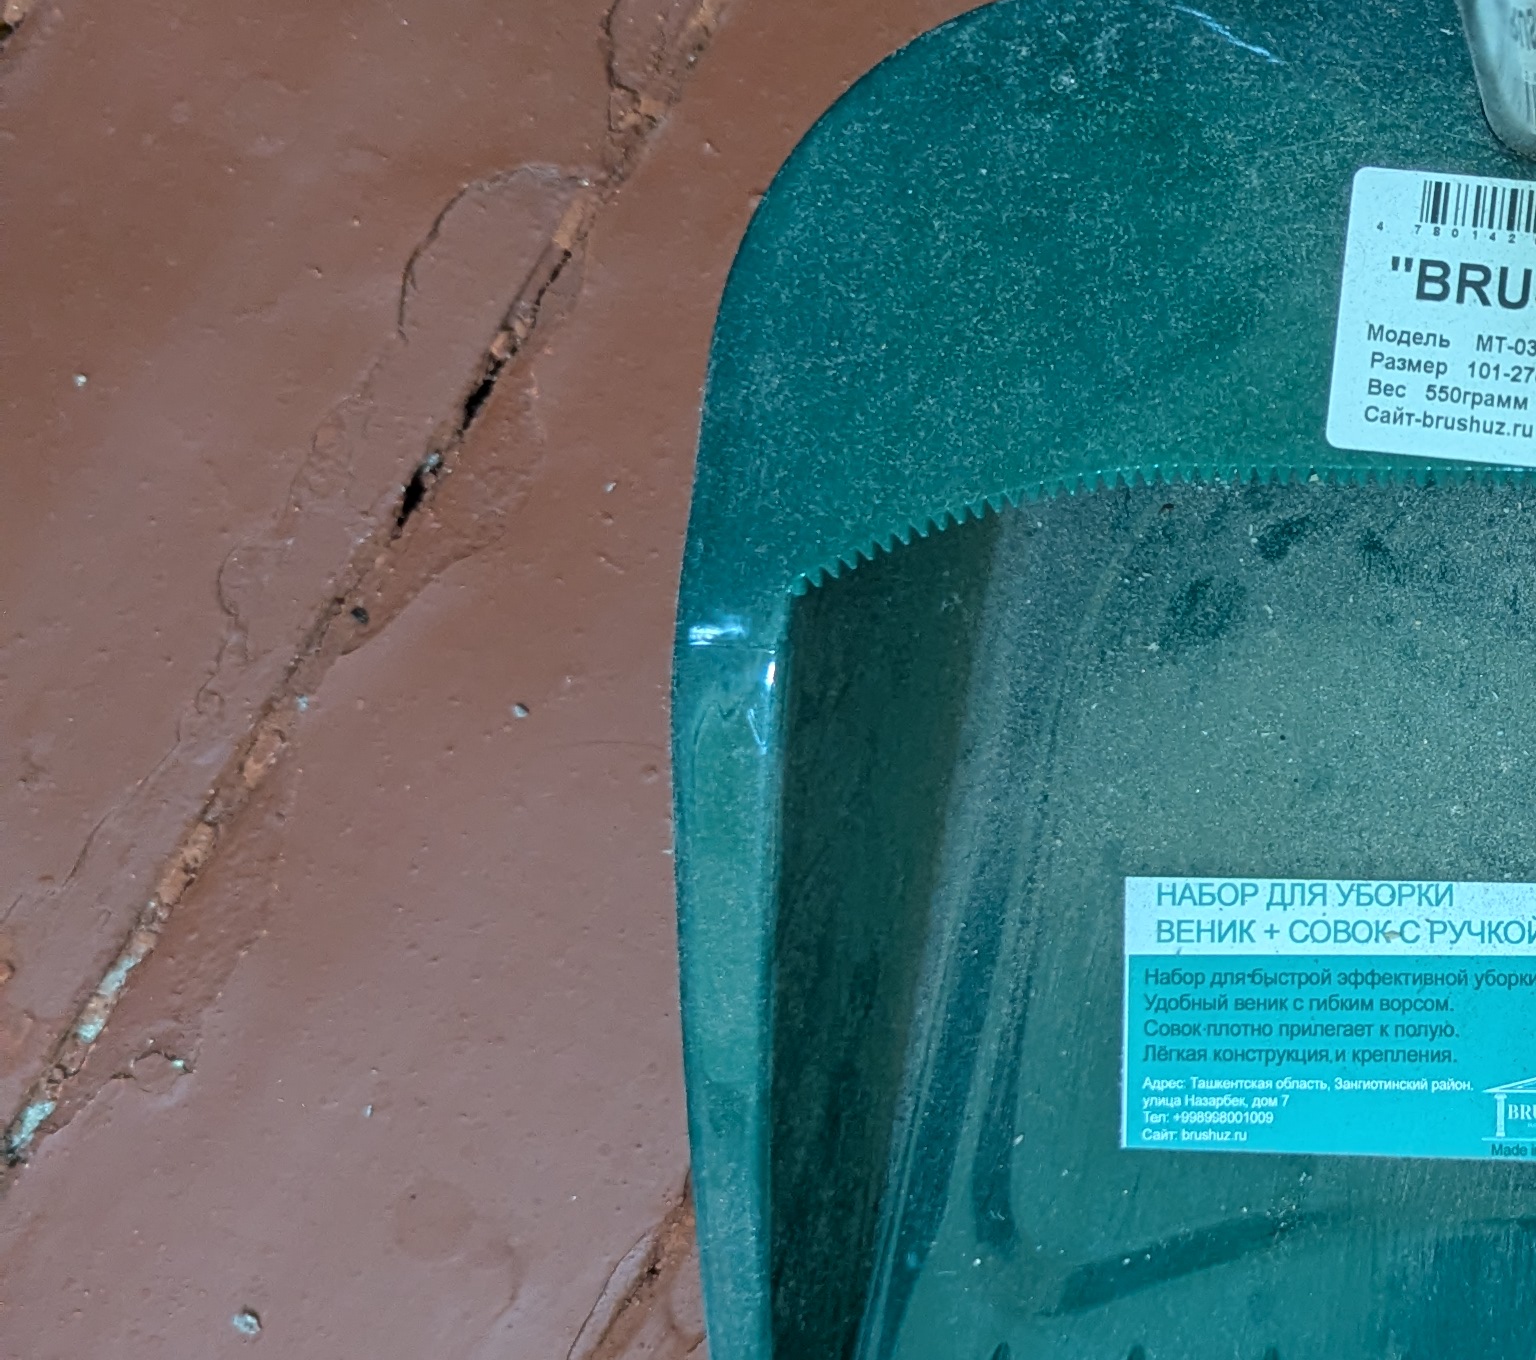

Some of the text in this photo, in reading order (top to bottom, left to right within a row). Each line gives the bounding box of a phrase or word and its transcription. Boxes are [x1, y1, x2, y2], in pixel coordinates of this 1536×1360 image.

[1376, 221, 1384, 232] 4
[1367, 323, 1450, 349] Модель
[1370, 351, 1448, 379] Размер
[1367, 378, 1529, 411] Вес 550грамм
[1364, 405, 1533, 438] Сайт-brushuz.ru
[1156, 882, 1454, 911] НАБОР ДЛЯ УБОРКИ
[1156, 919, 1256, 943] ВЕНИК
[1264, 923, 1280, 940] +
[1289, 919, 1392, 944] СОВОК
[1400, 919, 1421, 944] С
[1144, 968, 1206, 989] Набор
[1210, 972, 1247, 988] для
[1251, 968, 1332, 989] быстрой
[1337, 968, 1468, 989] эффективной
[1144, 993, 1454, 1017] Удобный веник с гибким ворсом.
[1143, 1019, 1460, 1042] Совок плотно прилегает к полую.
[1142, 1044, 1207, 1062] Лёгкая
[1335, 1049, 1346, 1062] и
[1352, 1049, 1458, 1067] крепления.
[1142, 1076, 1186, 1091] Адрес:
[1190, 1077, 1273, 1090] Ташкентская
[1276, 1077, 1331, 1091] область,
[1334, 1077, 1428, 1090] Зангиотинский
[1142, 1094, 1290, 1109] улица Назарбек, дом 7
[1143, 1111, 1169, 1124] Тел:
[1142, 1128, 1248, 1141] Сайт: brushuz.ru
[1491, 1143, 1528, 1157] Made
